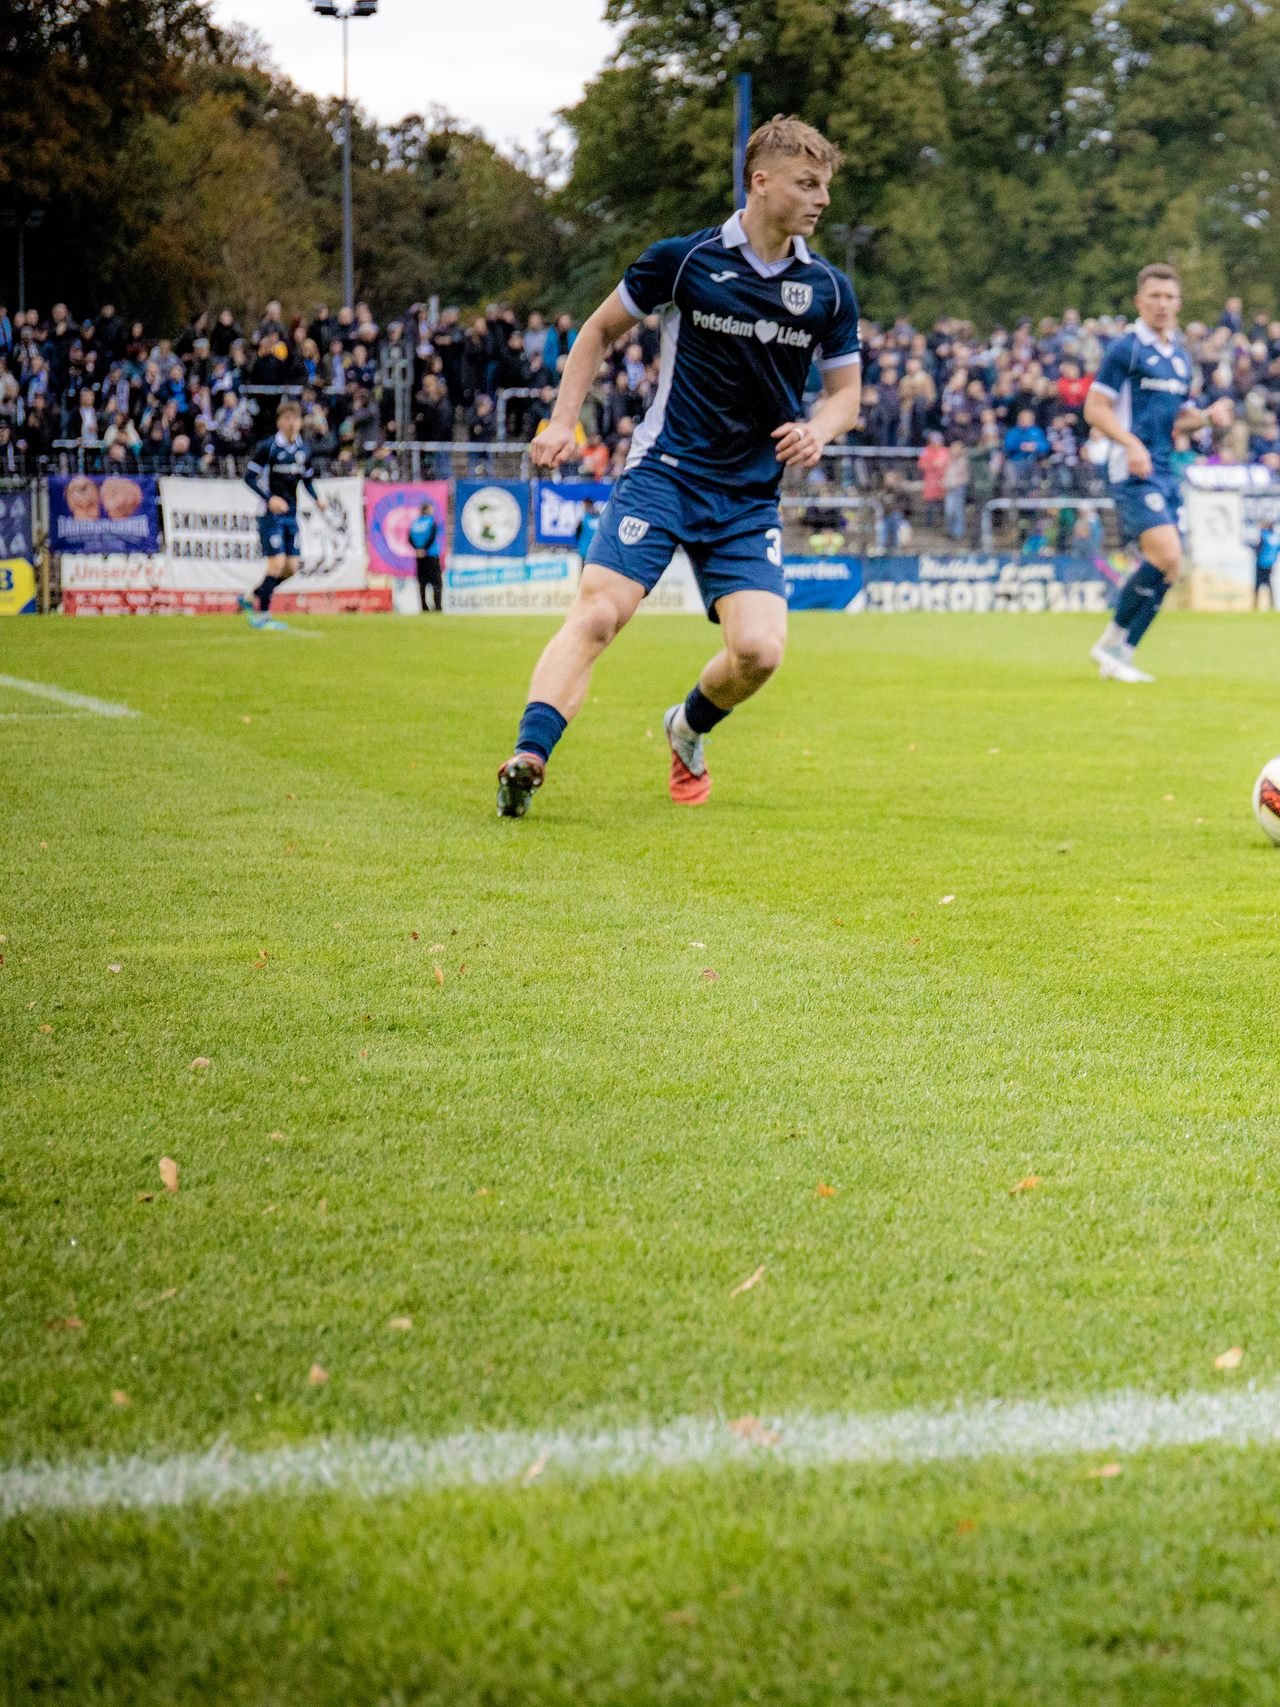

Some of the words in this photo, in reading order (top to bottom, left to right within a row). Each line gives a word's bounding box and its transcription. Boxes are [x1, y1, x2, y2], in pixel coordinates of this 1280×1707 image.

[692, 309, 754, 338] Potsdam
[776, 326, 812, 349] Liebe
[172, 540, 263, 559] BABELSBER
[764, 527, 782, 568] 3
